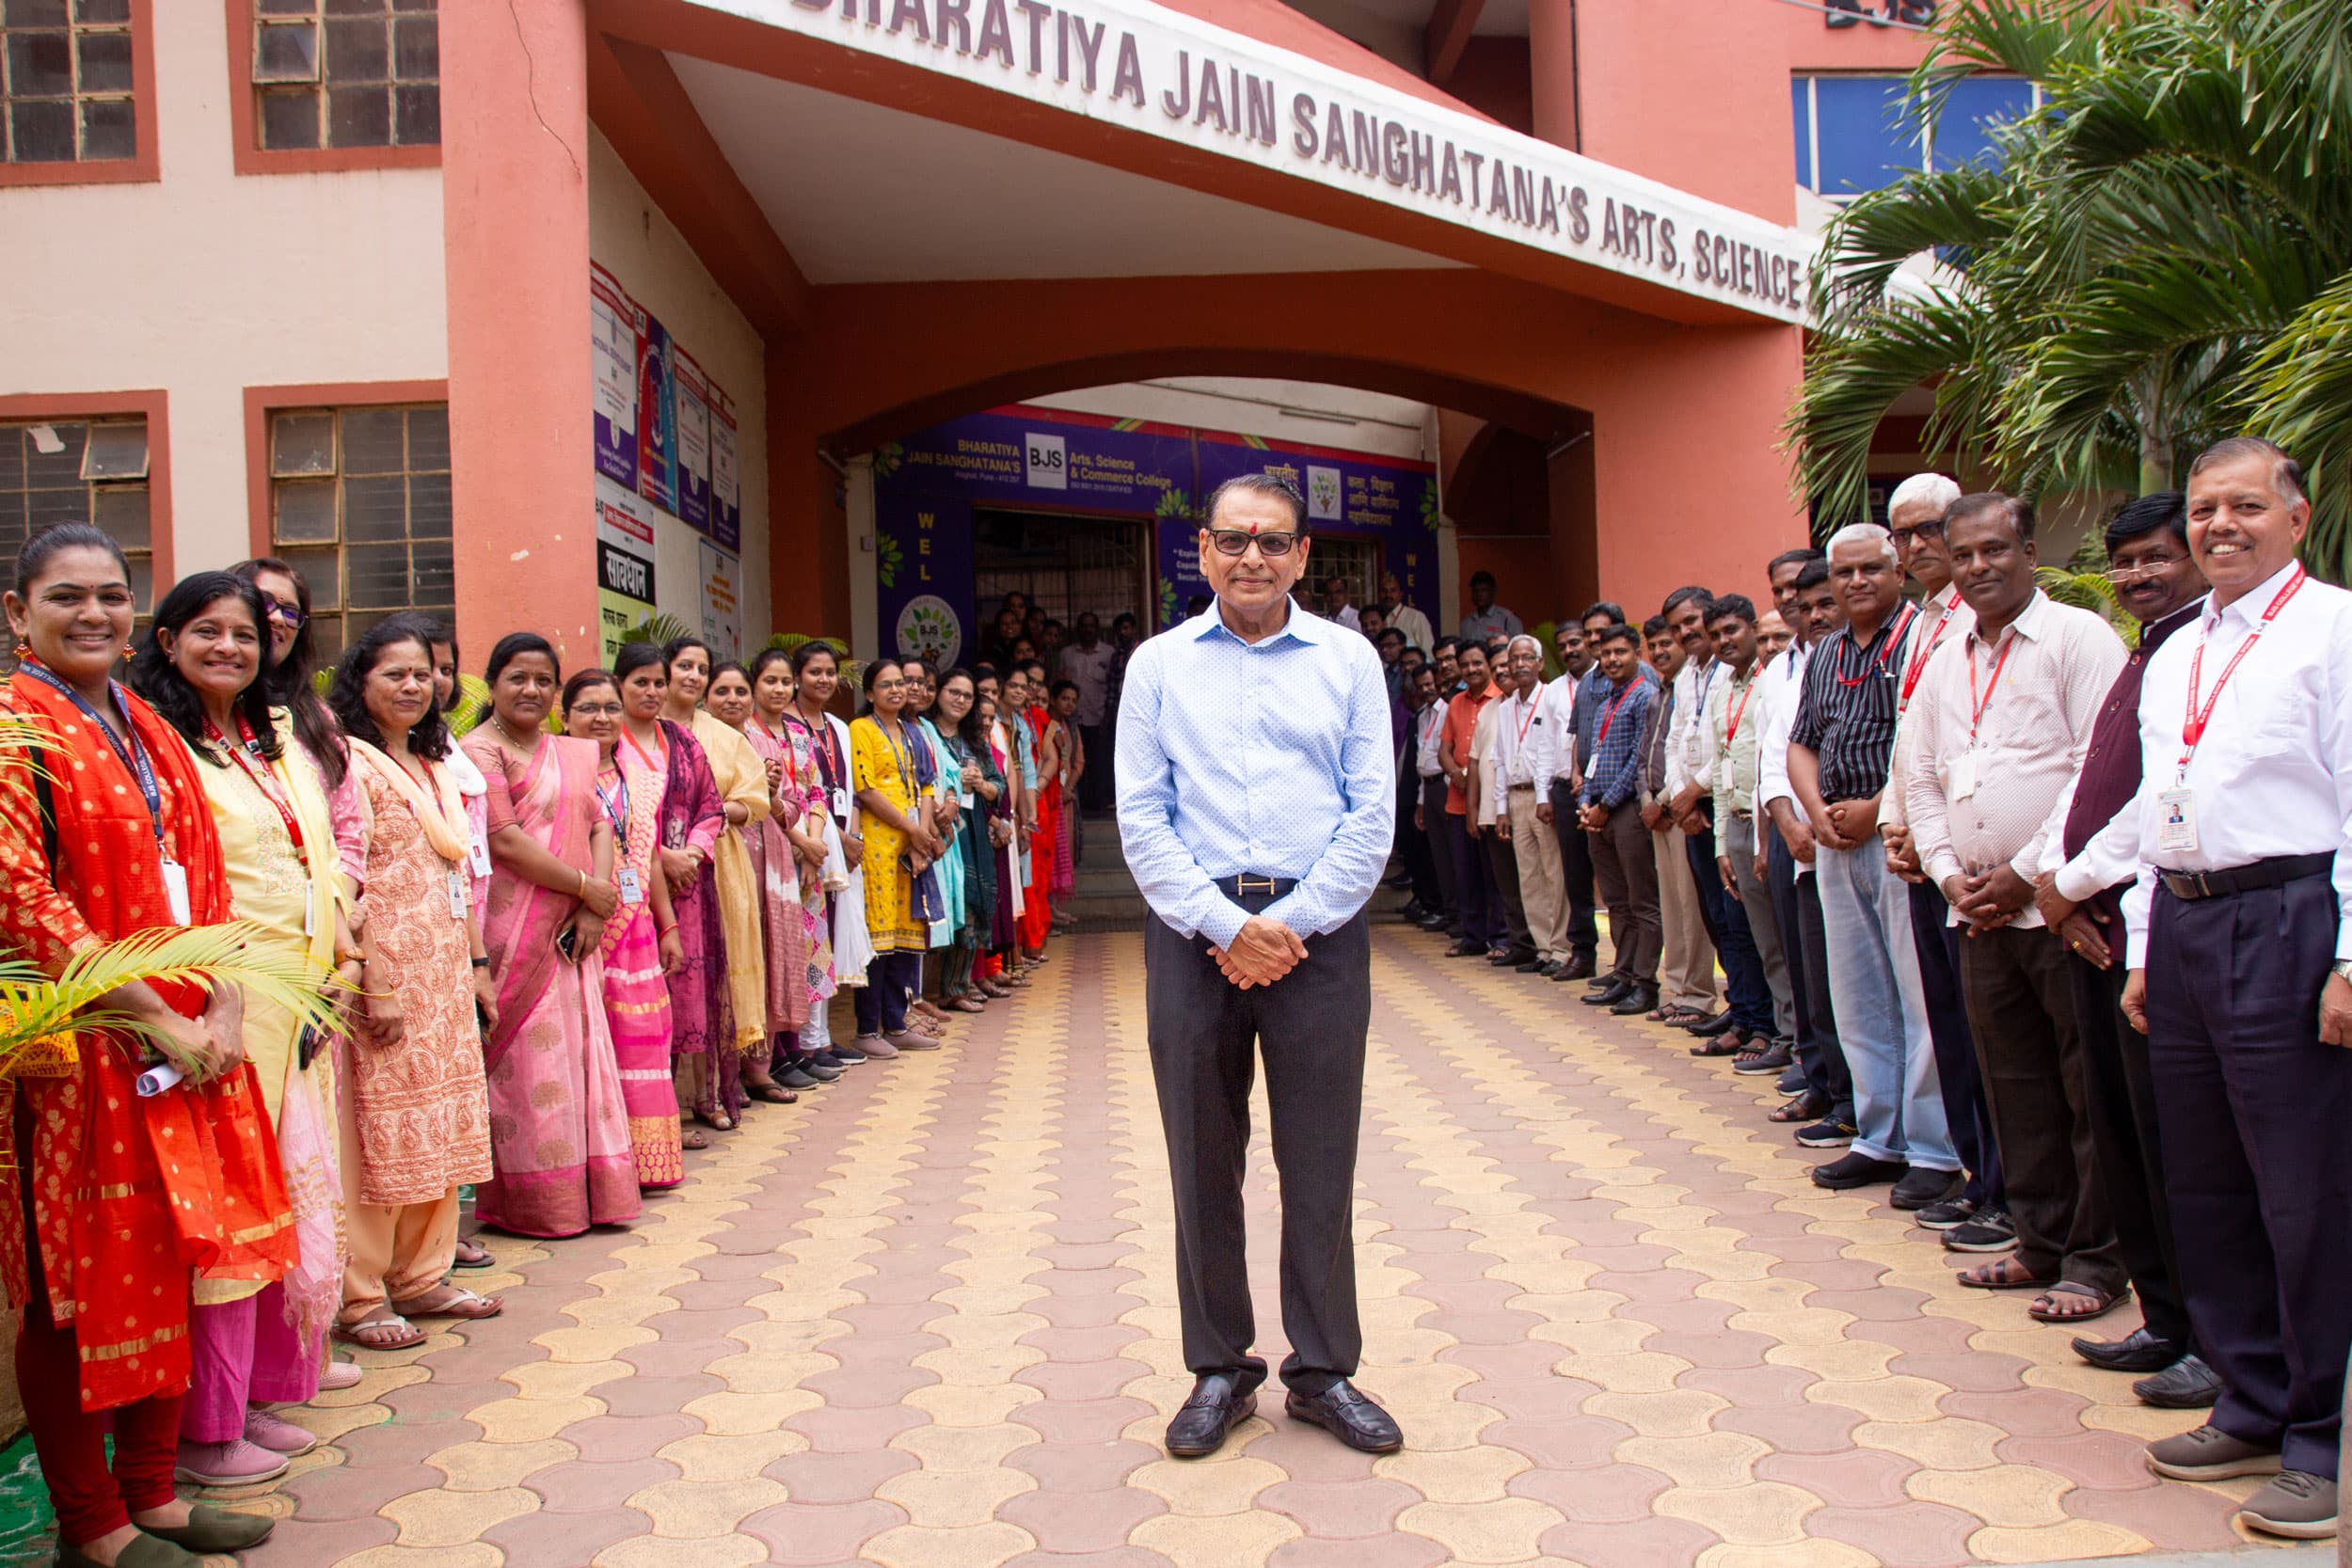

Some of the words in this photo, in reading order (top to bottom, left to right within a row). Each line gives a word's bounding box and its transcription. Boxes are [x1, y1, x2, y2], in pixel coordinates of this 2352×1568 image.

[788, 0, 1146, 107] ARATIYA
[1163, 50, 1277, 147] JAIN
[1293, 93, 1591, 245] SANGHATANA'S
[1601, 196, 1686, 279] ARTS,
[1694, 229, 1802, 310] SCIENCE
[957, 438, 1020, 458] BHARATIYA
[1029, 447, 1062, 469] BJS
[907, 451, 934, 467] JAIN
[936, 452, 1021, 474] SANGHATANA'S
[1096, 453, 1135, 471] Science
[1071, 467, 1079, 478] &
[1081, 468, 1134, 485] Commerce
[1136, 472, 1172, 490] College
[605, 547, 647, 598] सावधान
